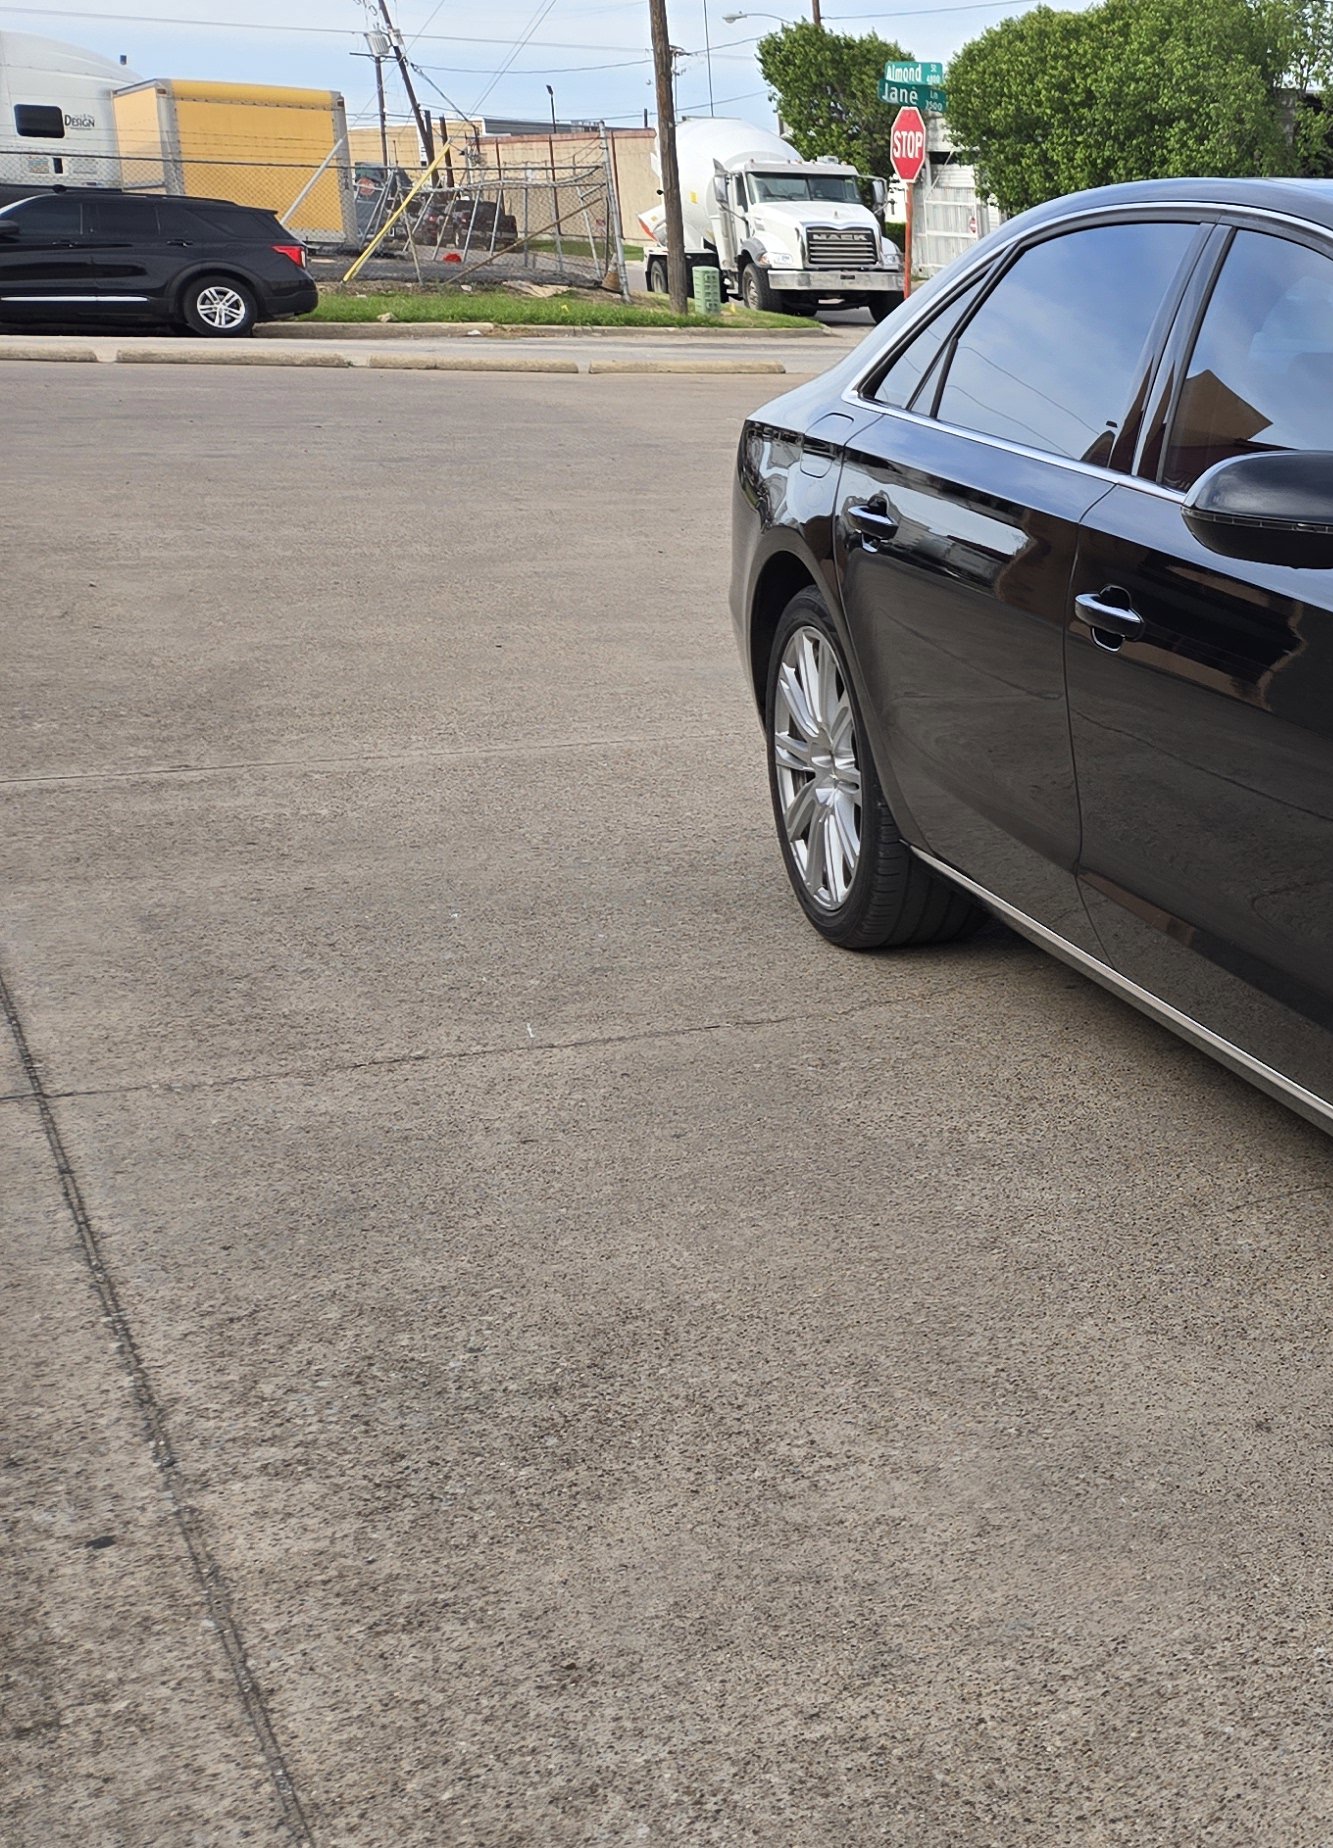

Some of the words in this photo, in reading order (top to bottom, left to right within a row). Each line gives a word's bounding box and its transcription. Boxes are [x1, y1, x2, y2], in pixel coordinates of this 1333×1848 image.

[885, 63, 922, 82] Almond
[882, 82, 918, 105] Jane
[893, 131, 924, 159] STOP
